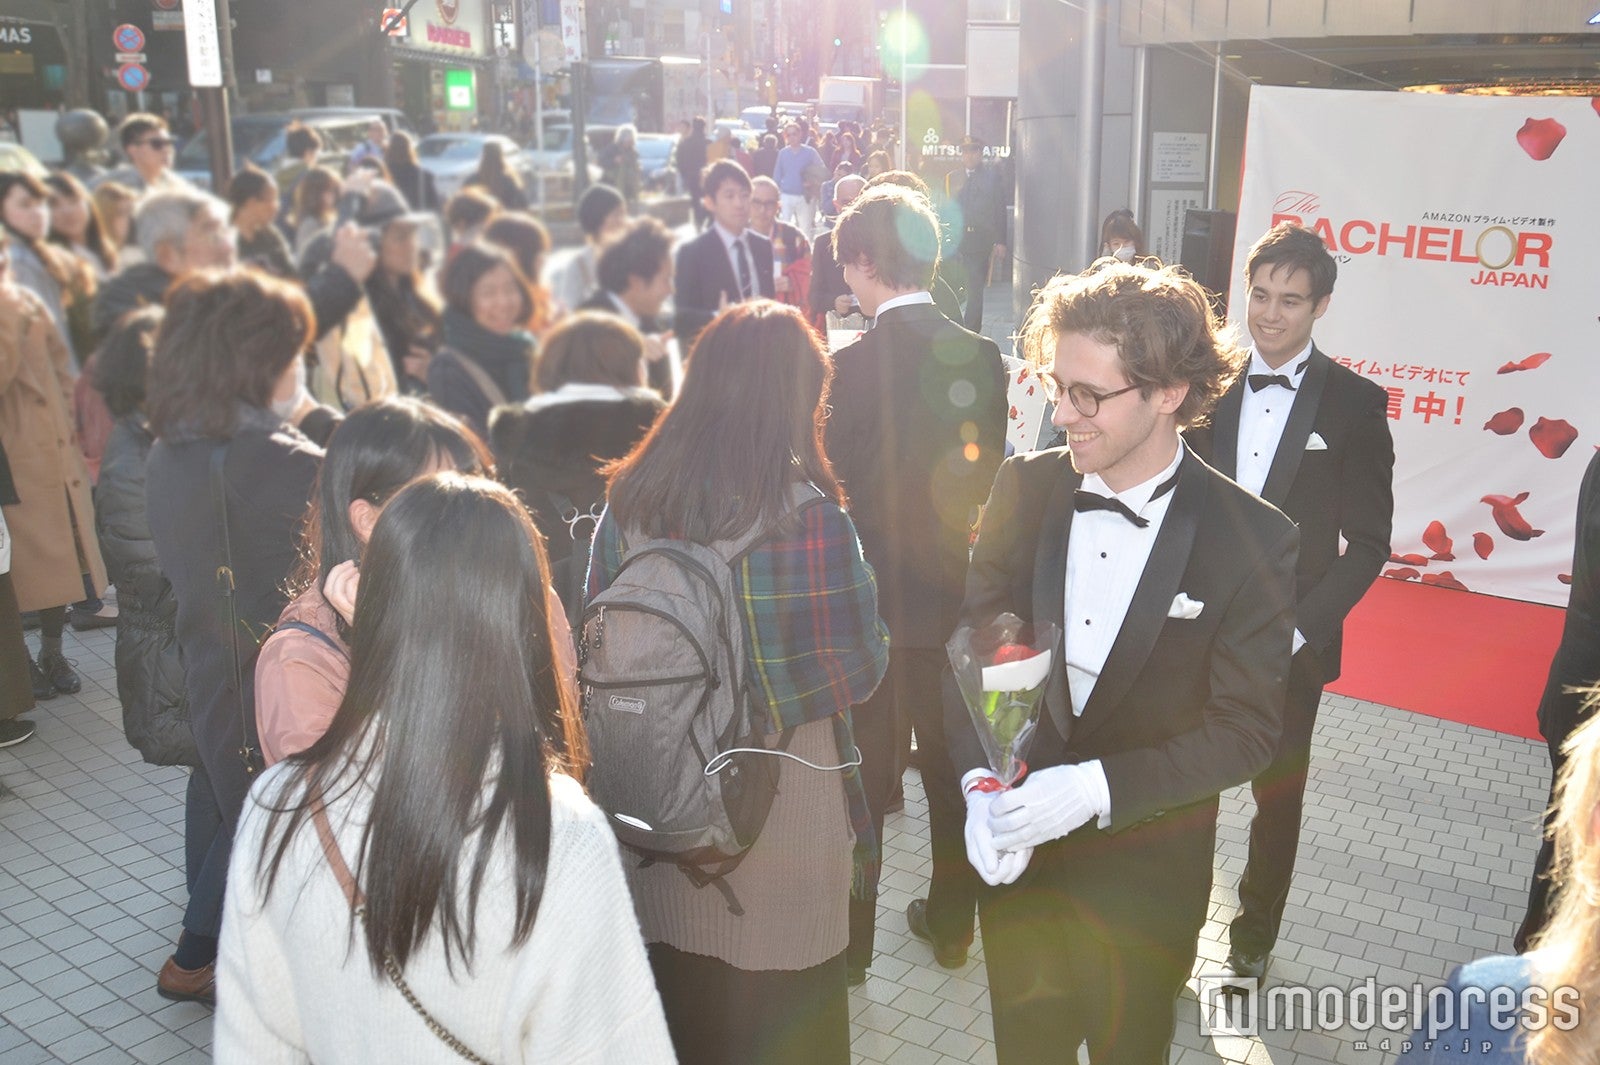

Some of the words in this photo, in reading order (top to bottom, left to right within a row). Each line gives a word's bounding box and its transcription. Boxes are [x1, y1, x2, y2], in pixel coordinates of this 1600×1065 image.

[1272, 190, 1321, 213] The
[1422, 211, 1471, 223] AMAZON
[1470, 270, 1549, 289] JAPAN
[1331, 355, 1471, 386] ライム・ビデオにて
